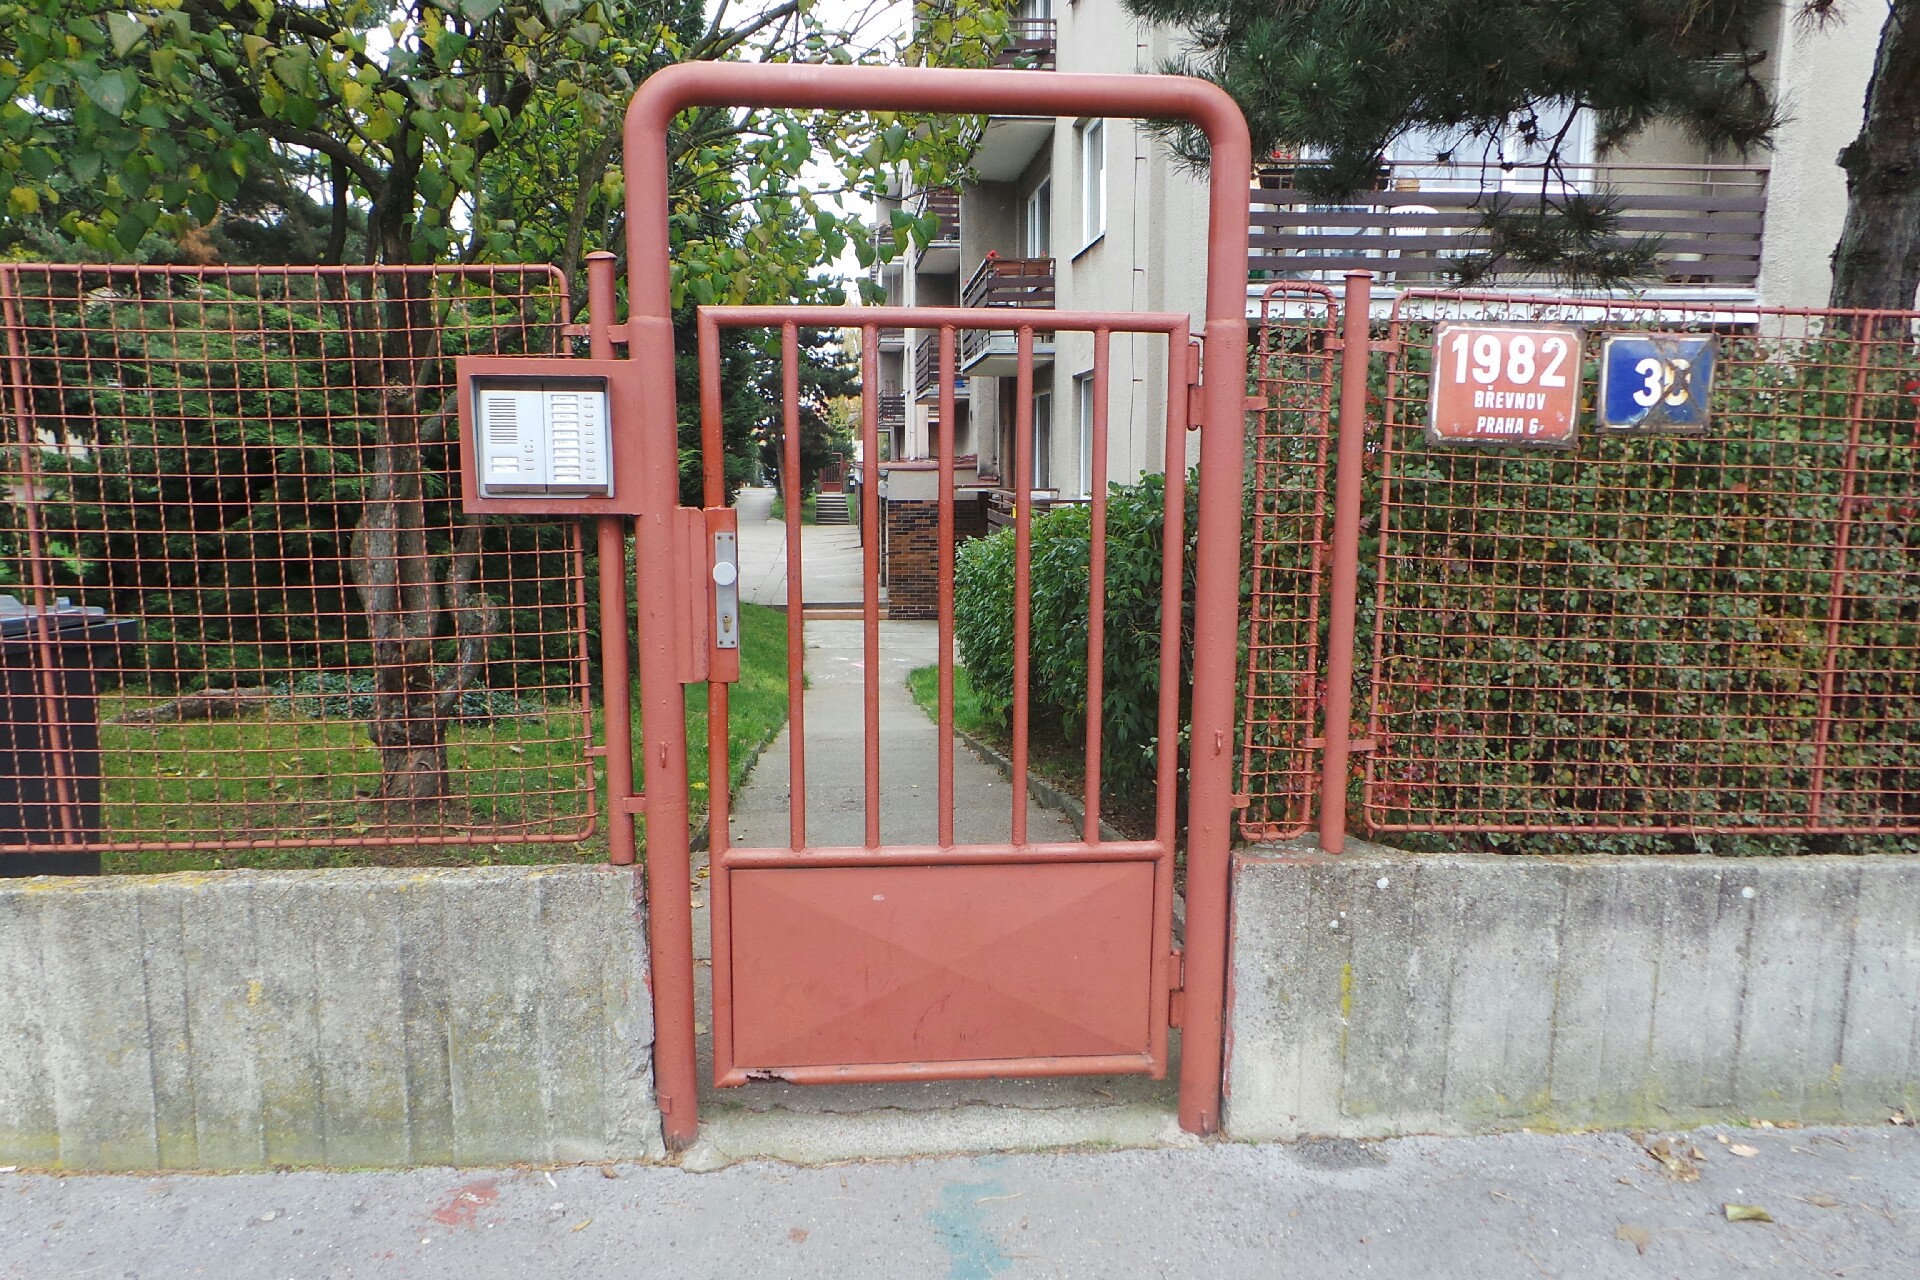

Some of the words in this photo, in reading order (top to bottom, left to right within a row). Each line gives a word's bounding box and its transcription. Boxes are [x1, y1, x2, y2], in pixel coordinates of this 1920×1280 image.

[1452, 333, 1568, 387] 1982
[1474, 385, 1546, 410] BŘEVNOV
[1476, 416, 1524, 434] PRAHA
[1529, 417, 1539, 434] 6
